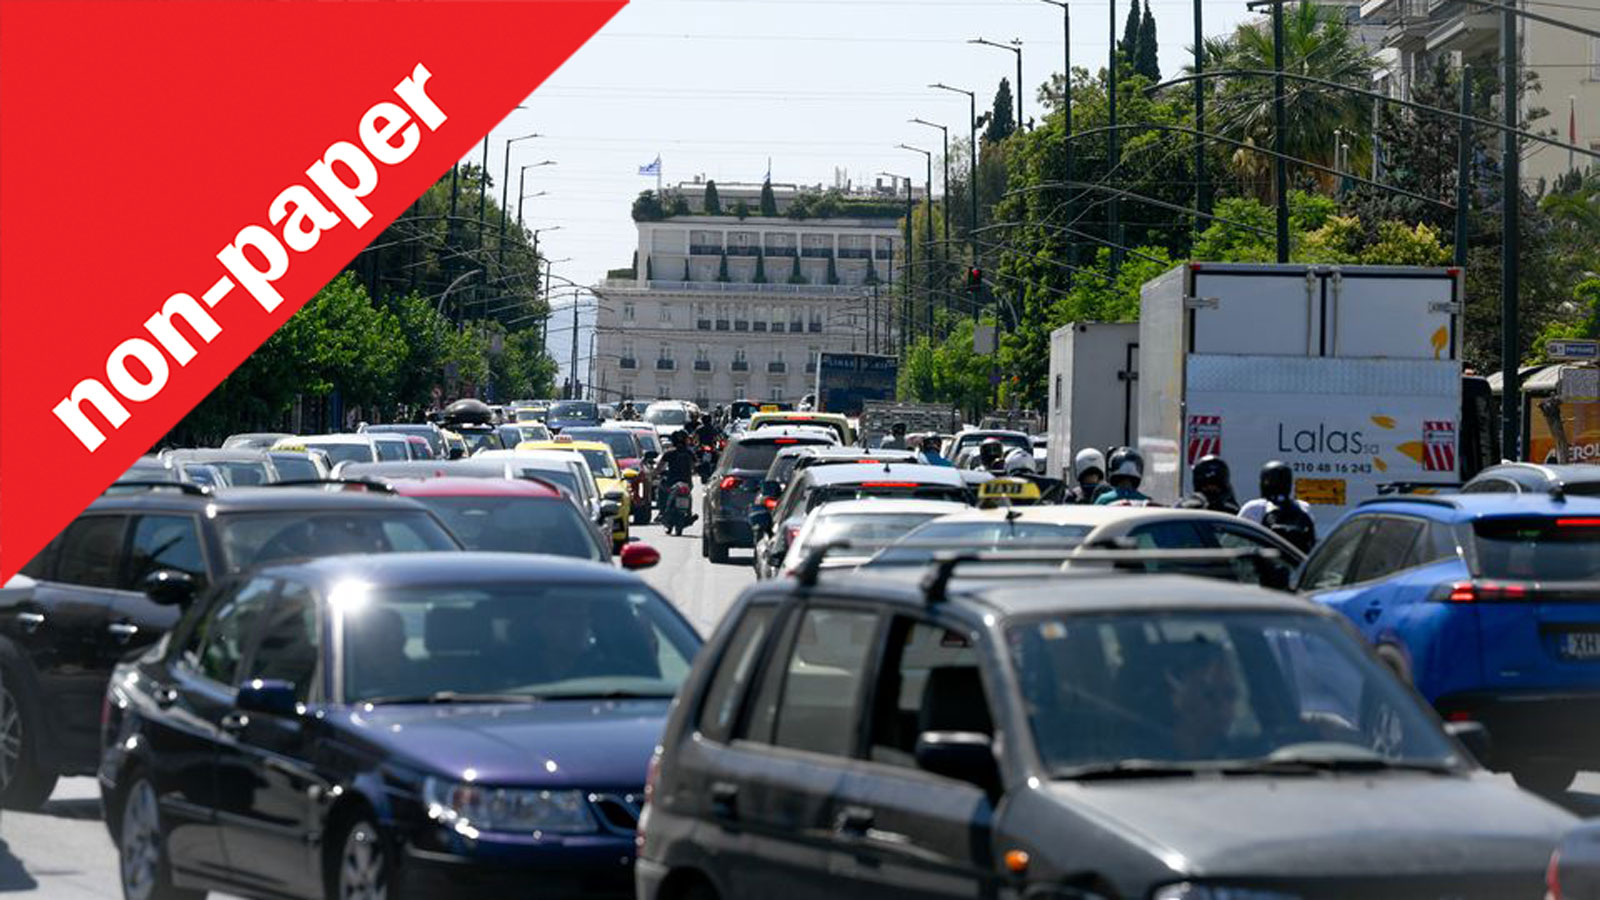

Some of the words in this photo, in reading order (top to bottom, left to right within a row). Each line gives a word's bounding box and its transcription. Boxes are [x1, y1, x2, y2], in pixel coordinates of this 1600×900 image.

[1278, 422, 1363, 454] Lalas
[1293, 462, 1314, 473] 210
[1316, 463, 1331, 473] 48
[1335, 463, 1348, 473] 16
[1351, 463, 1373, 474] 243
